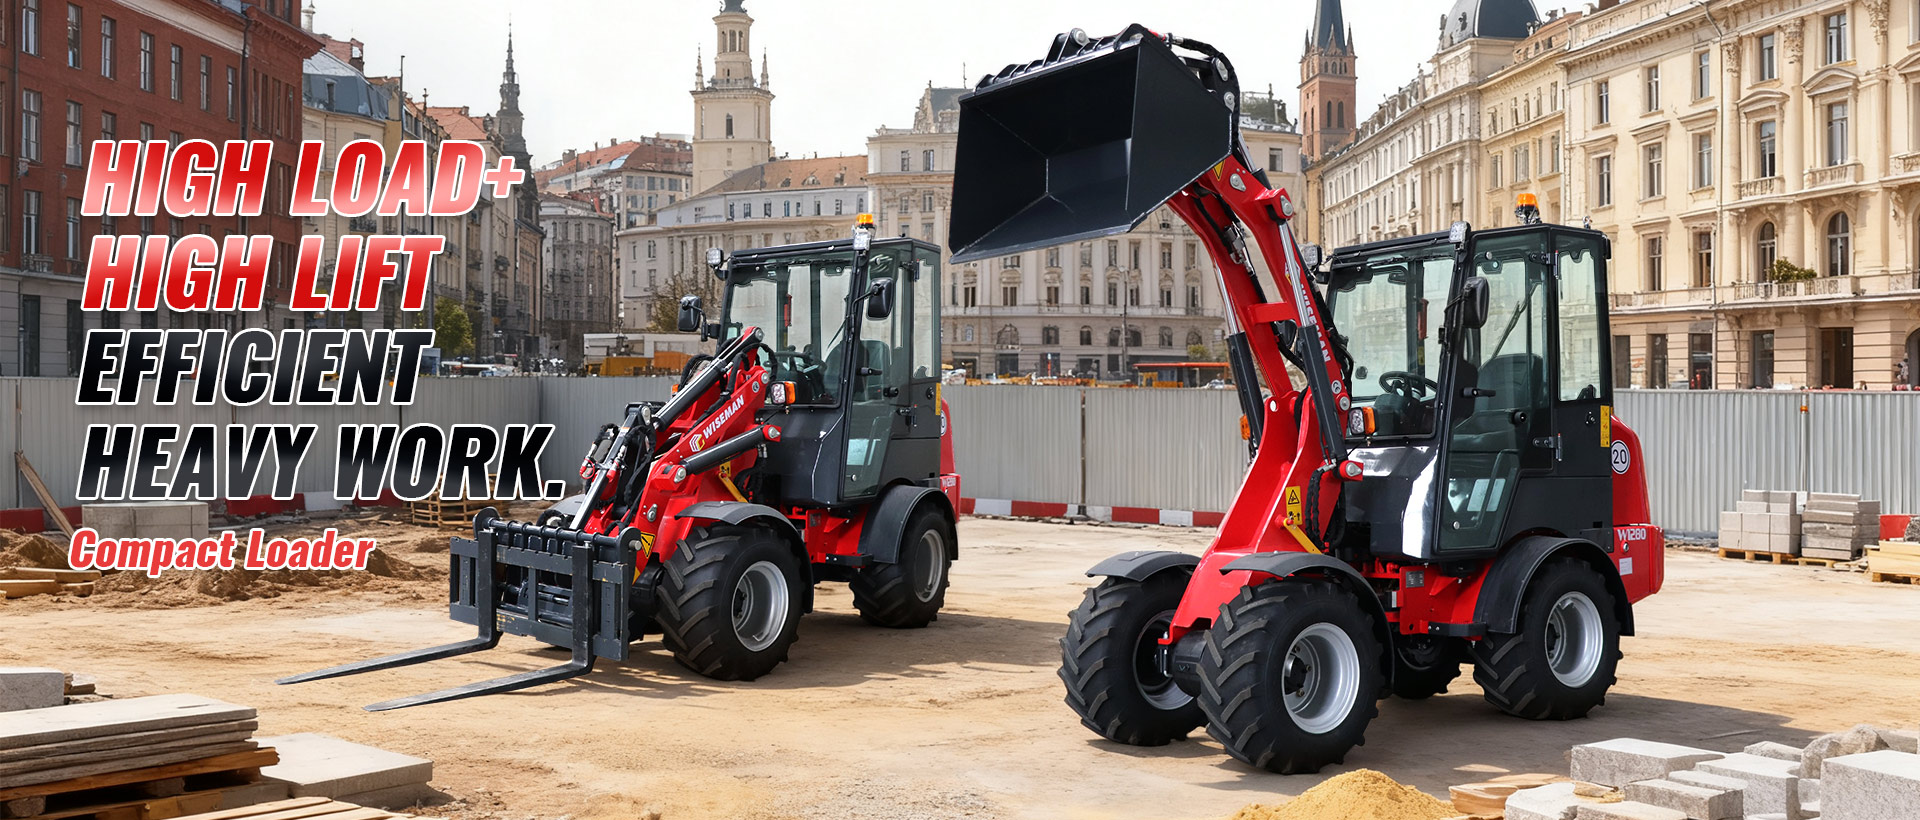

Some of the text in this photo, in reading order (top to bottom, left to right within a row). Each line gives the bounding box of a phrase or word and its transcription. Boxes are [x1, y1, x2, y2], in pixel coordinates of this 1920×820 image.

[702, 394, 745, 439] WISEMAN
[1612, 449, 1627, 465] 20
[1617, 528, 1646, 541] W1280
